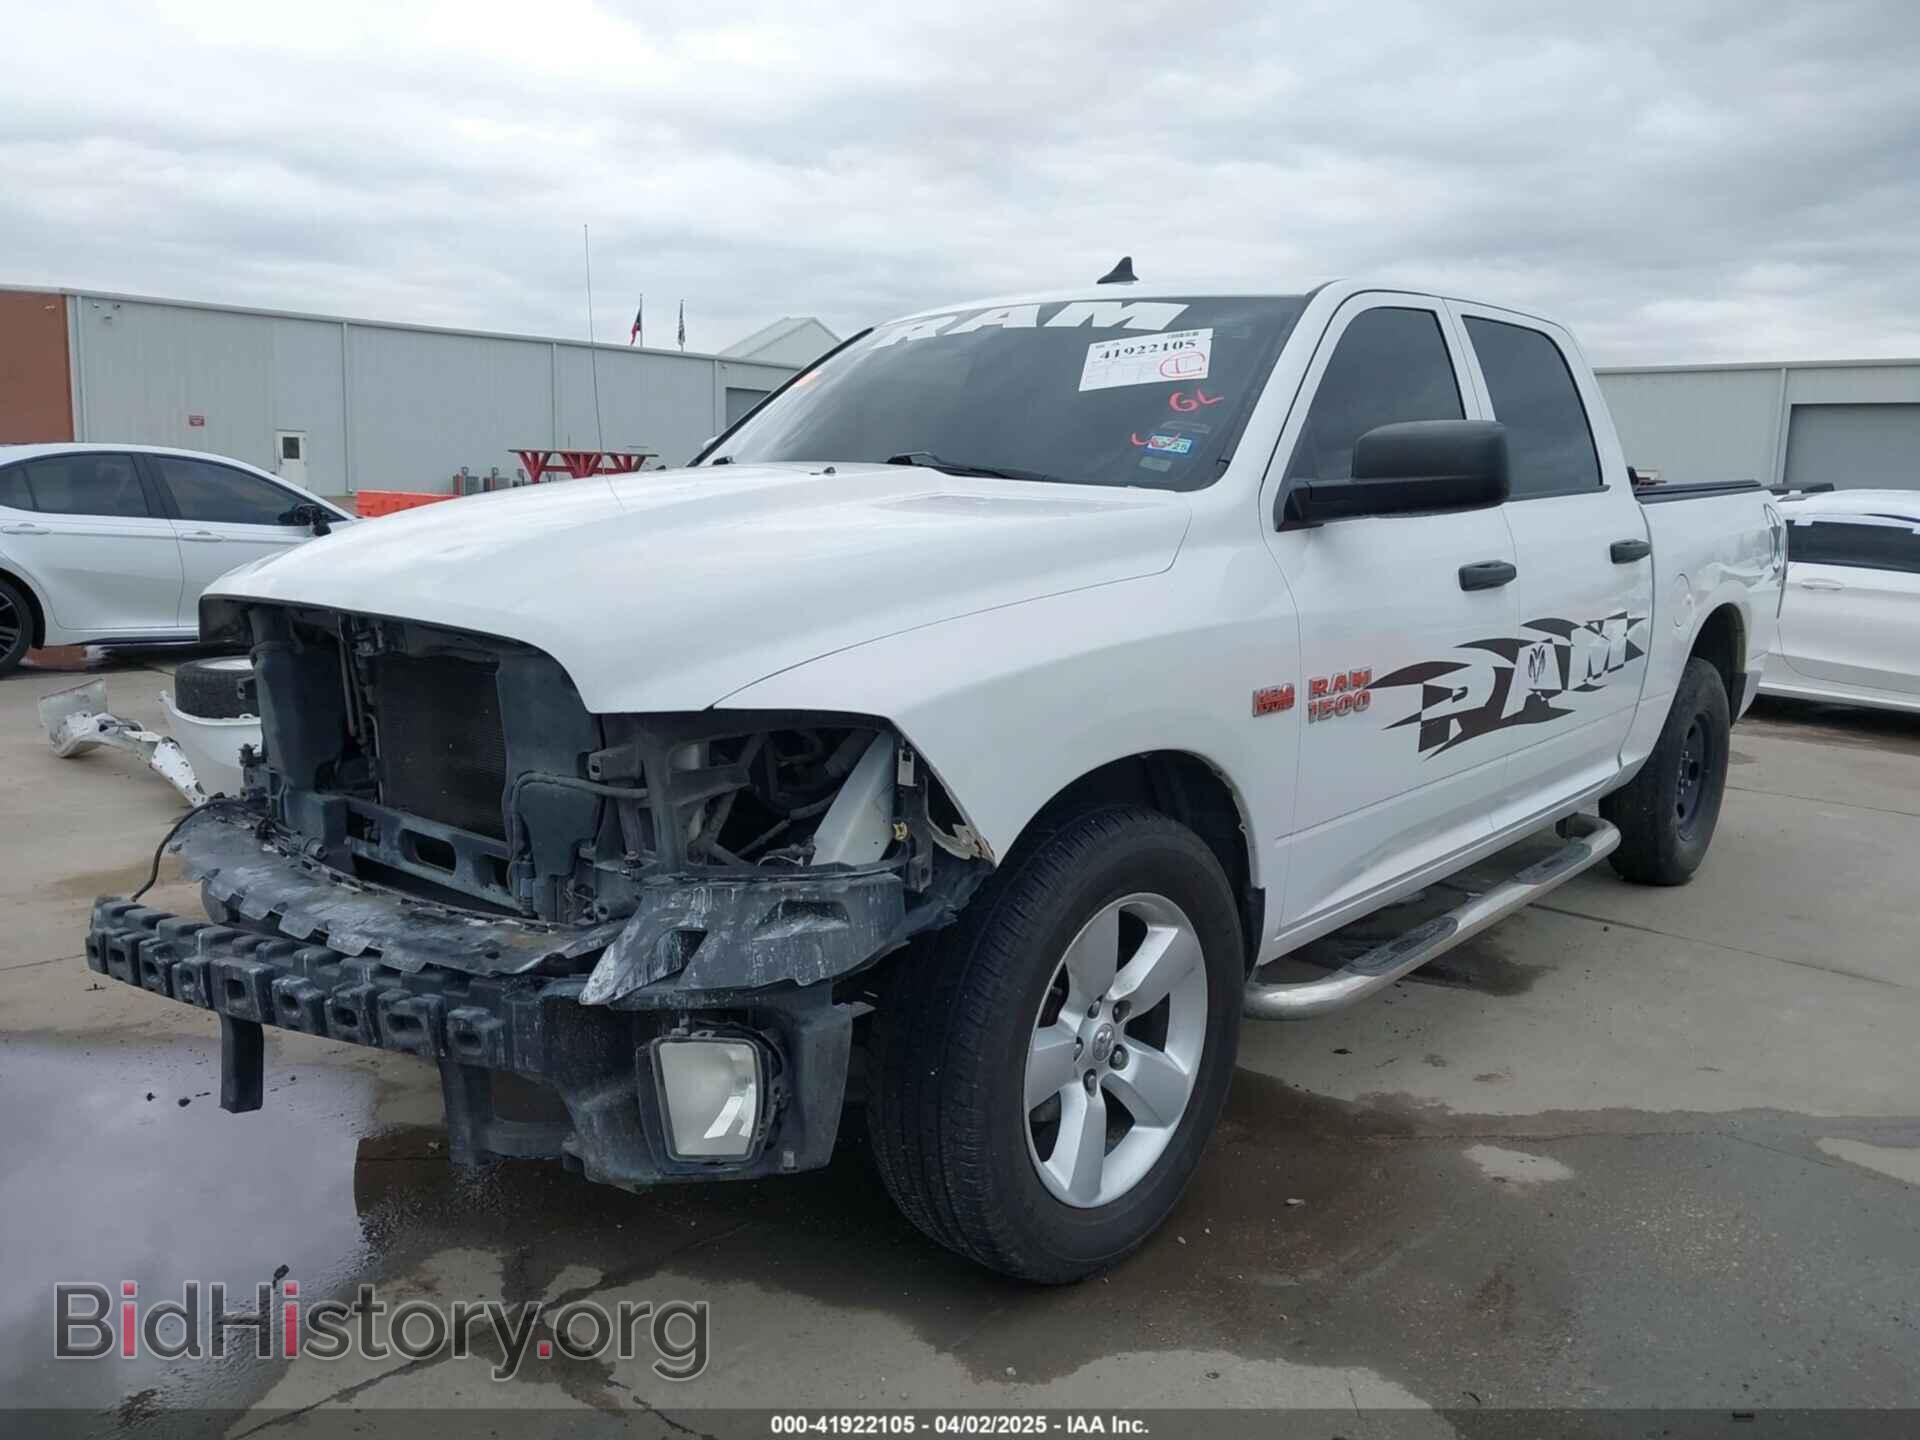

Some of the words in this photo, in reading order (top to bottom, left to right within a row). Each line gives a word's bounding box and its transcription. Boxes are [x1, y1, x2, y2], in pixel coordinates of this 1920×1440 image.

[870, 301, 1189, 350] RAM
[1099, 340, 1196, 359] 41922105
[1308, 667, 1373, 700] RAM
[1308, 691, 1371, 724] 1500
